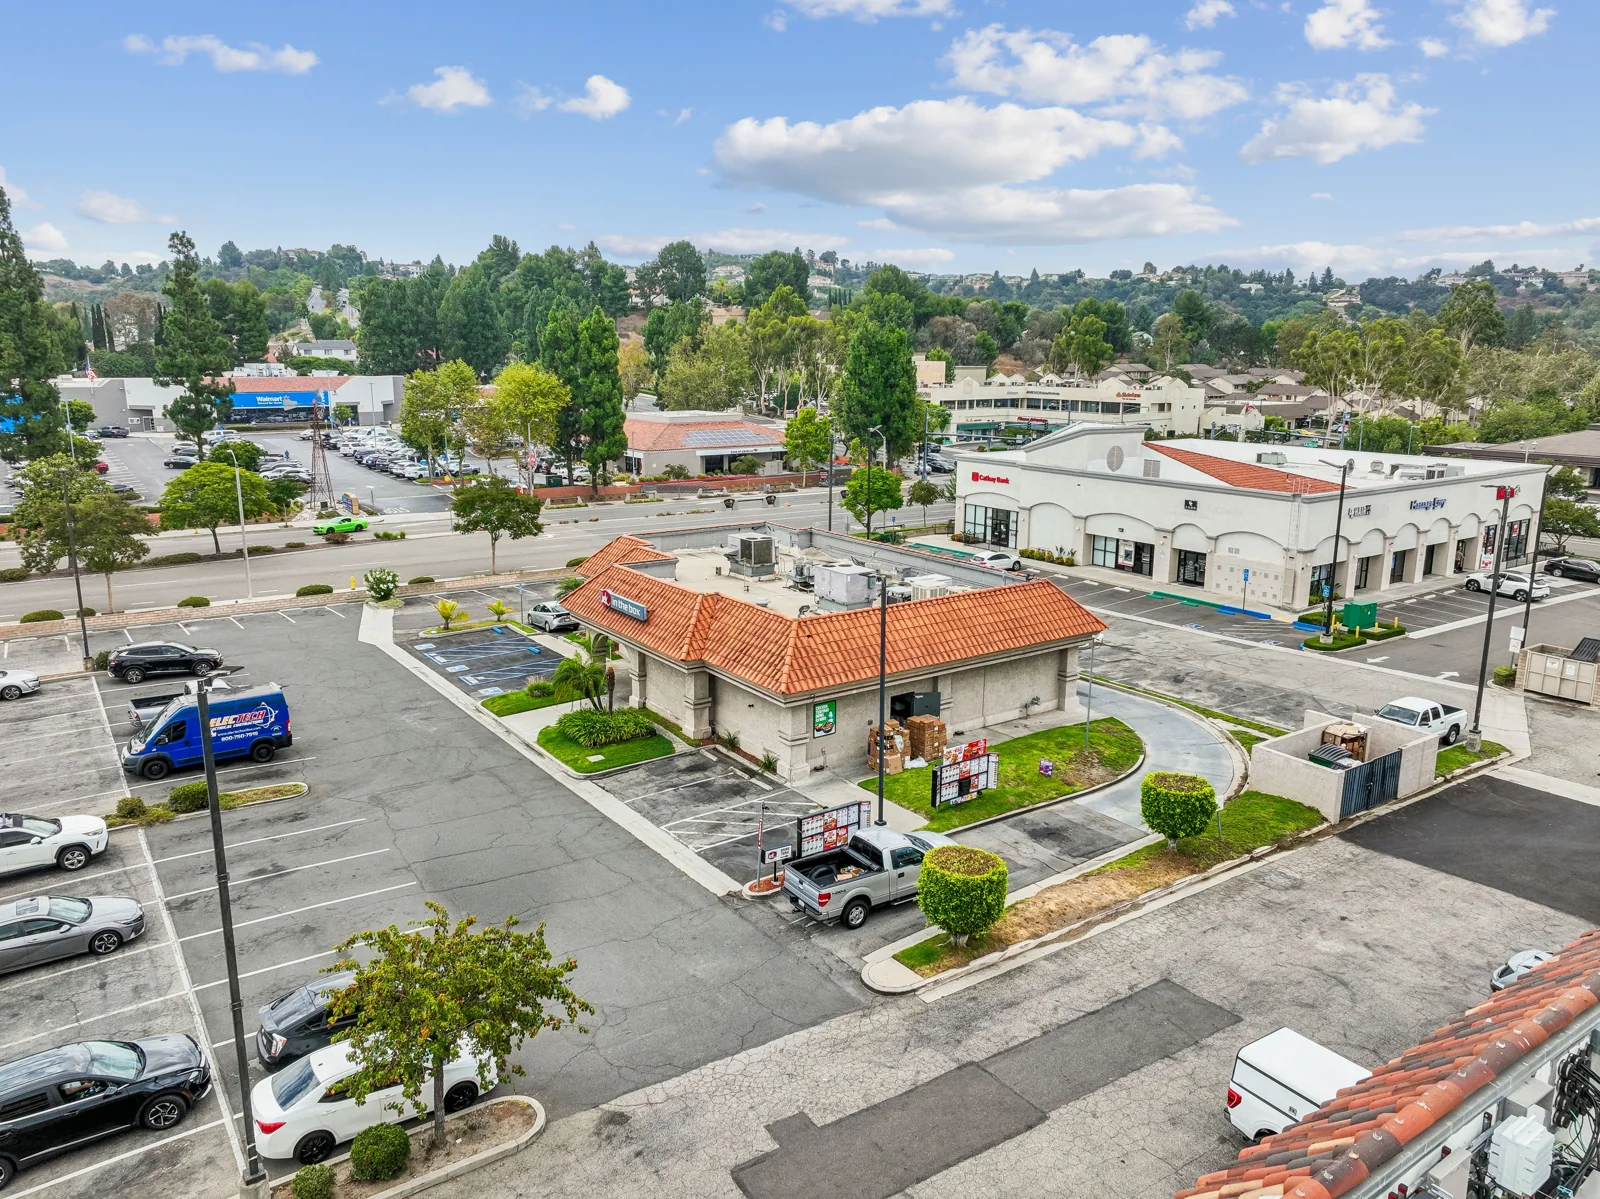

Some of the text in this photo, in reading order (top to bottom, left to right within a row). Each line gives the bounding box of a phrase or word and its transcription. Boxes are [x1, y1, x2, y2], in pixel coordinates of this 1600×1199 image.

[612, 596, 641, 616] in the box
[209, 710, 266, 728] ELECTECH
